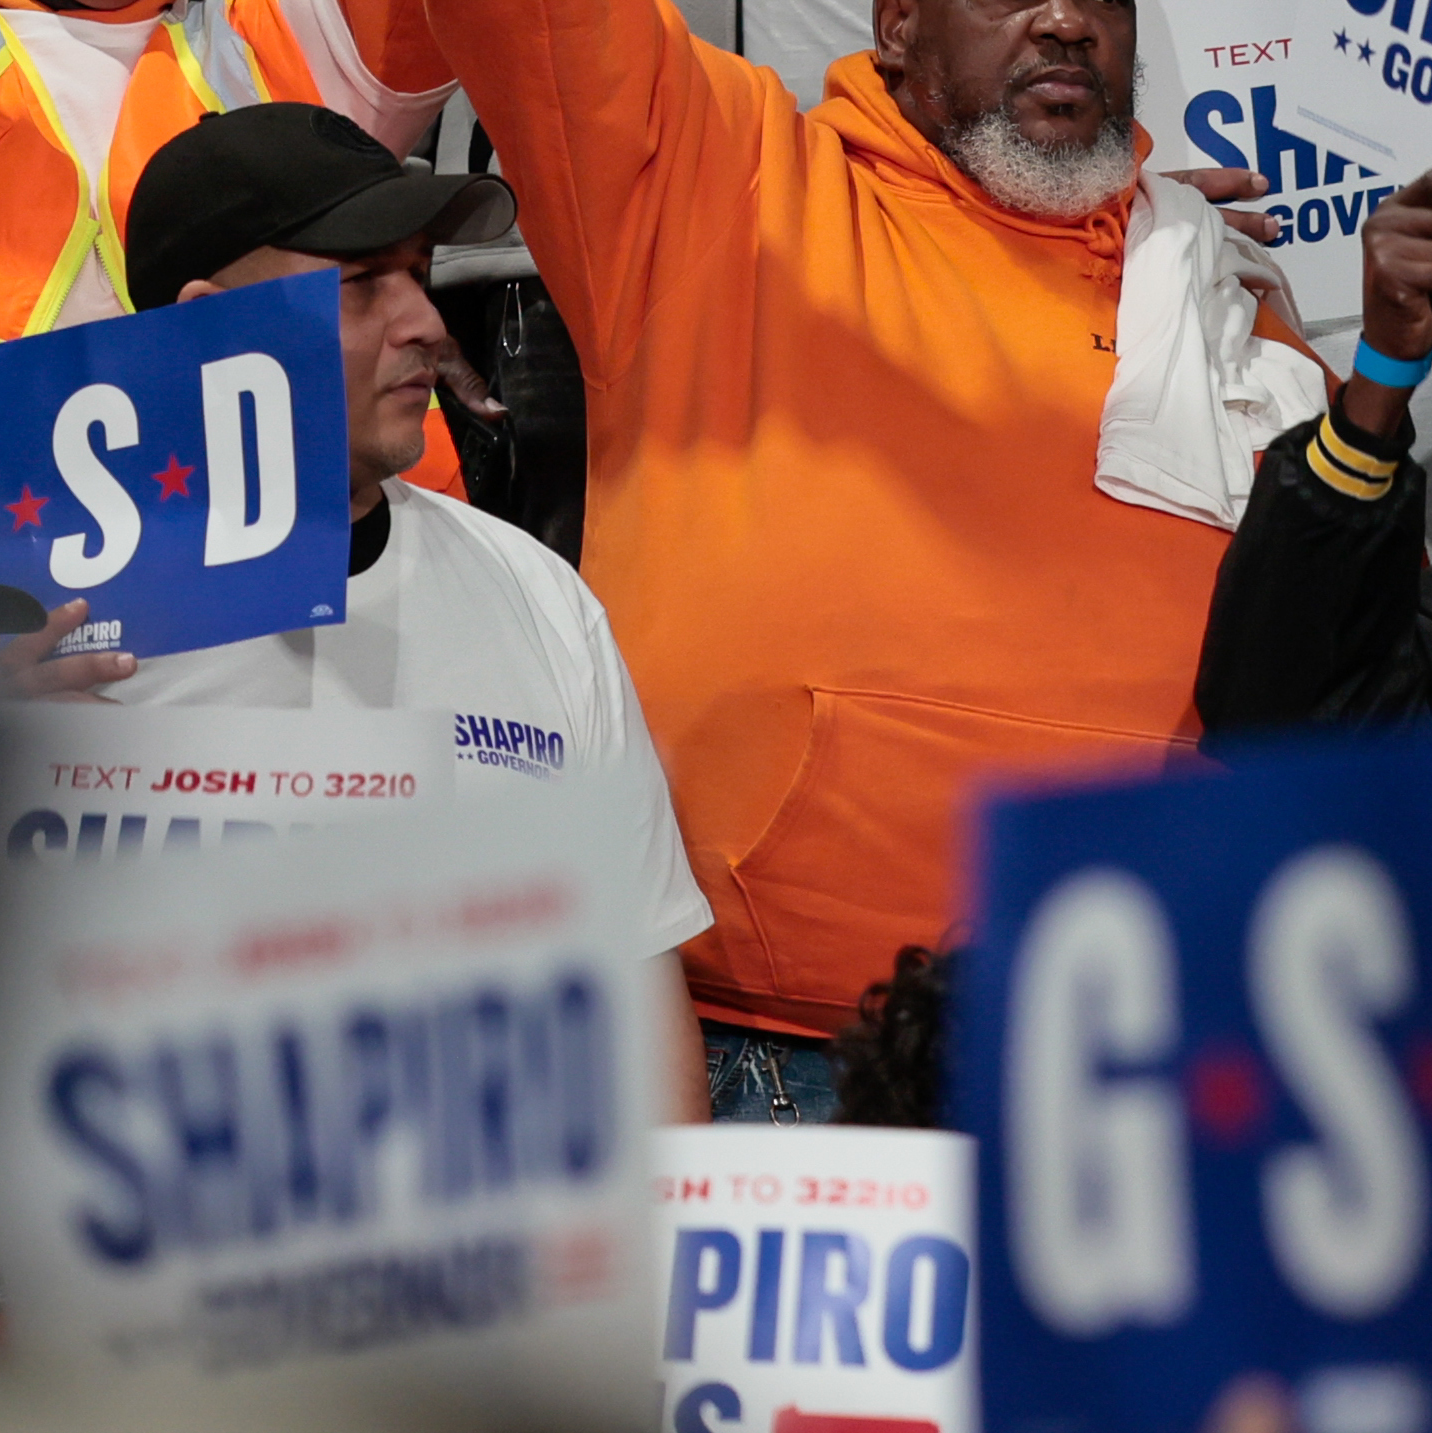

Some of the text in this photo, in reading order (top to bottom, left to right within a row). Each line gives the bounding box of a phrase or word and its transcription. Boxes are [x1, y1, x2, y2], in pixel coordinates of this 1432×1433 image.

[1204, 38, 1293, 68] TEXT
[455, 713, 564, 770] SHAPIRO
[51, 764, 417, 799] TEXT JOSH TO 32210
[47, 962, 617, 1268] SHAPIRO
[663, 1228, 969, 1374] PIRO
